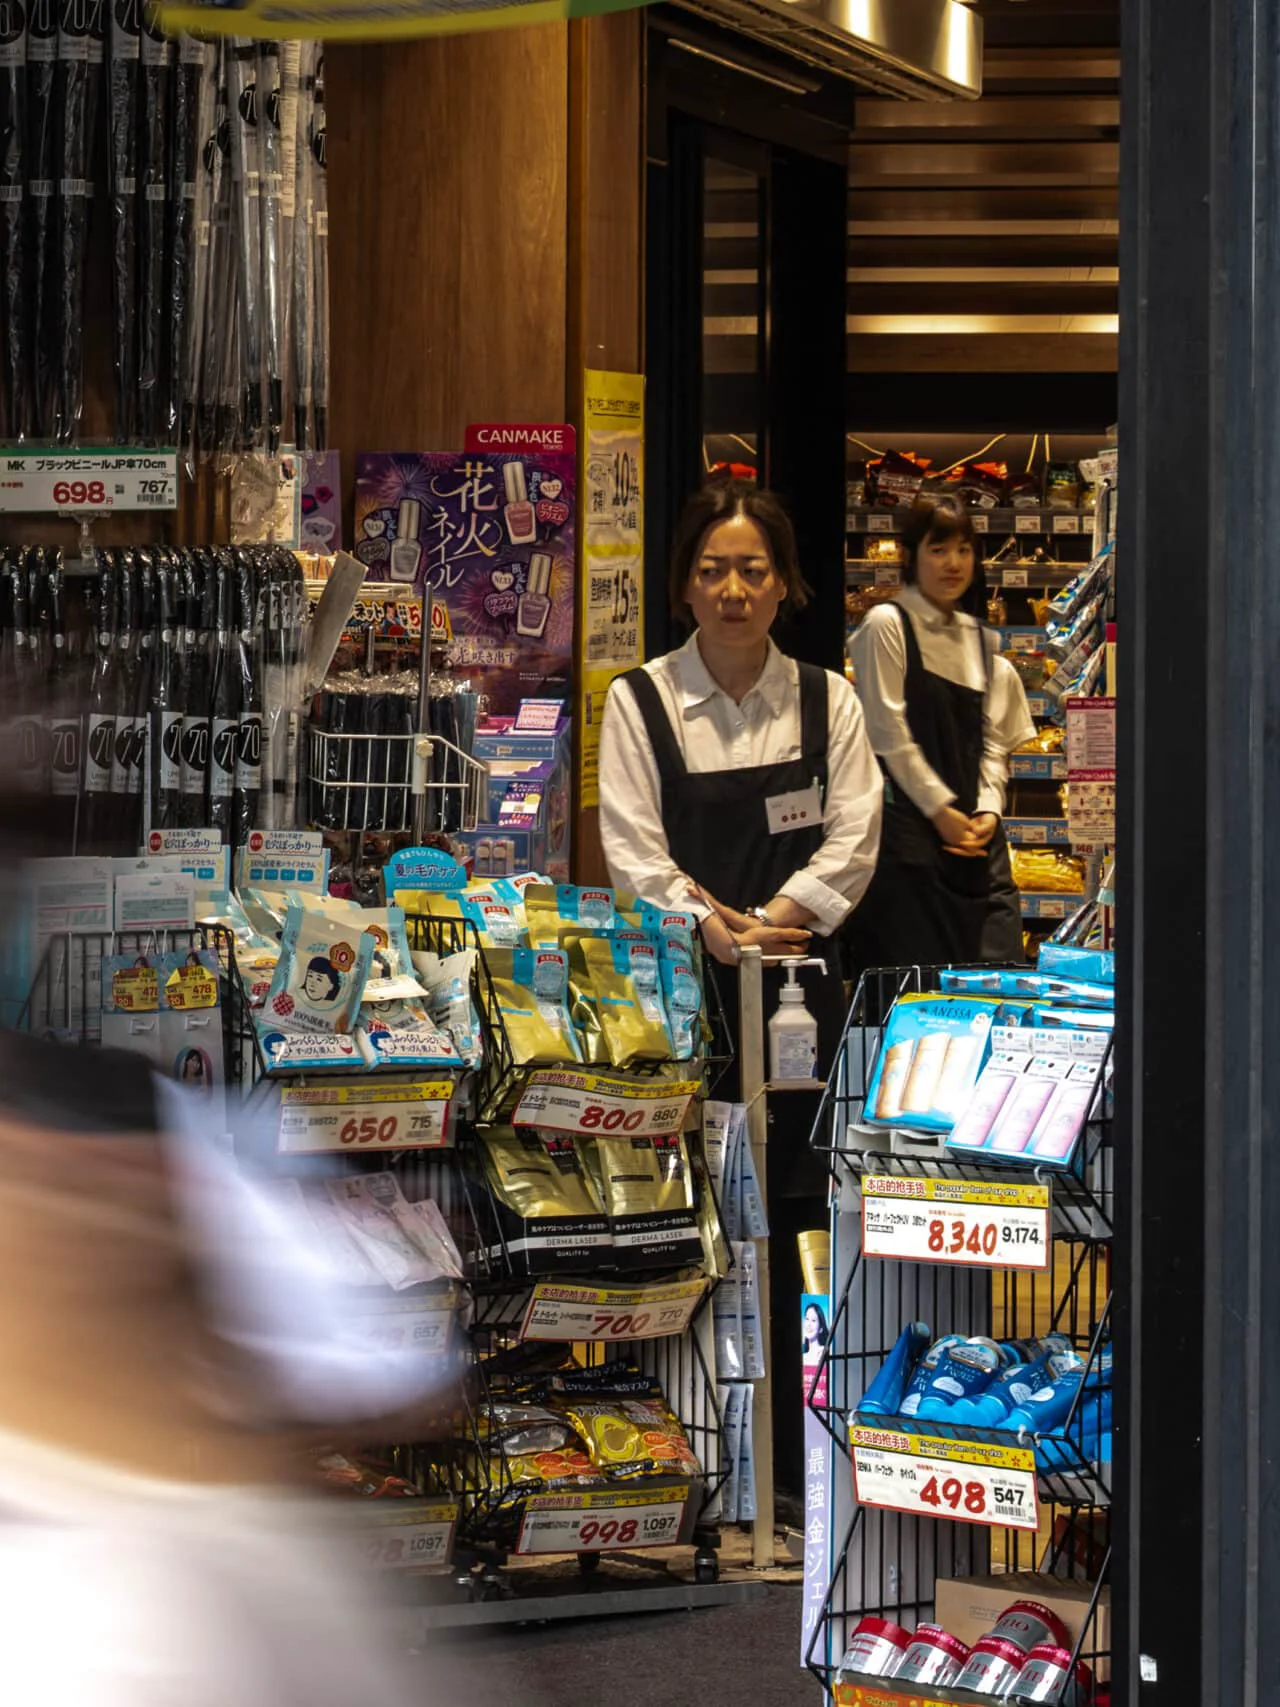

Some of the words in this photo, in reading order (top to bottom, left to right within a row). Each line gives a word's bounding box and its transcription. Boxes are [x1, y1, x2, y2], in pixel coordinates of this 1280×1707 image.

[477, 429, 564, 444] CANMAKE
[7, 460, 26, 472] MK
[53, 481, 106, 504] 698
[139, 480, 168, 495] 767
[240, 724, 261, 759] 70
[410, 1115, 432, 1130] 715
[579, 1105, 646, 1131] 800
[651, 1108, 679, 1122] 880
[339, 1115, 399, 1144] 650
[546, 1237, 572, 1246] DERMA
[574, 1236, 598, 1245] LASER
[631, 1235, 658, 1244] DERMA
[660, 1231, 684, 1240] LASER
[591, 1313, 651, 1335] 700
[658, 1308, 683, 1321] 770
[920, 1475, 987, 1514] 498
[994, 1487, 1025, 1506] 547
[579, 1519, 639, 1545] 998
[806, 1446, 825, 1630] 最強金ジェル
